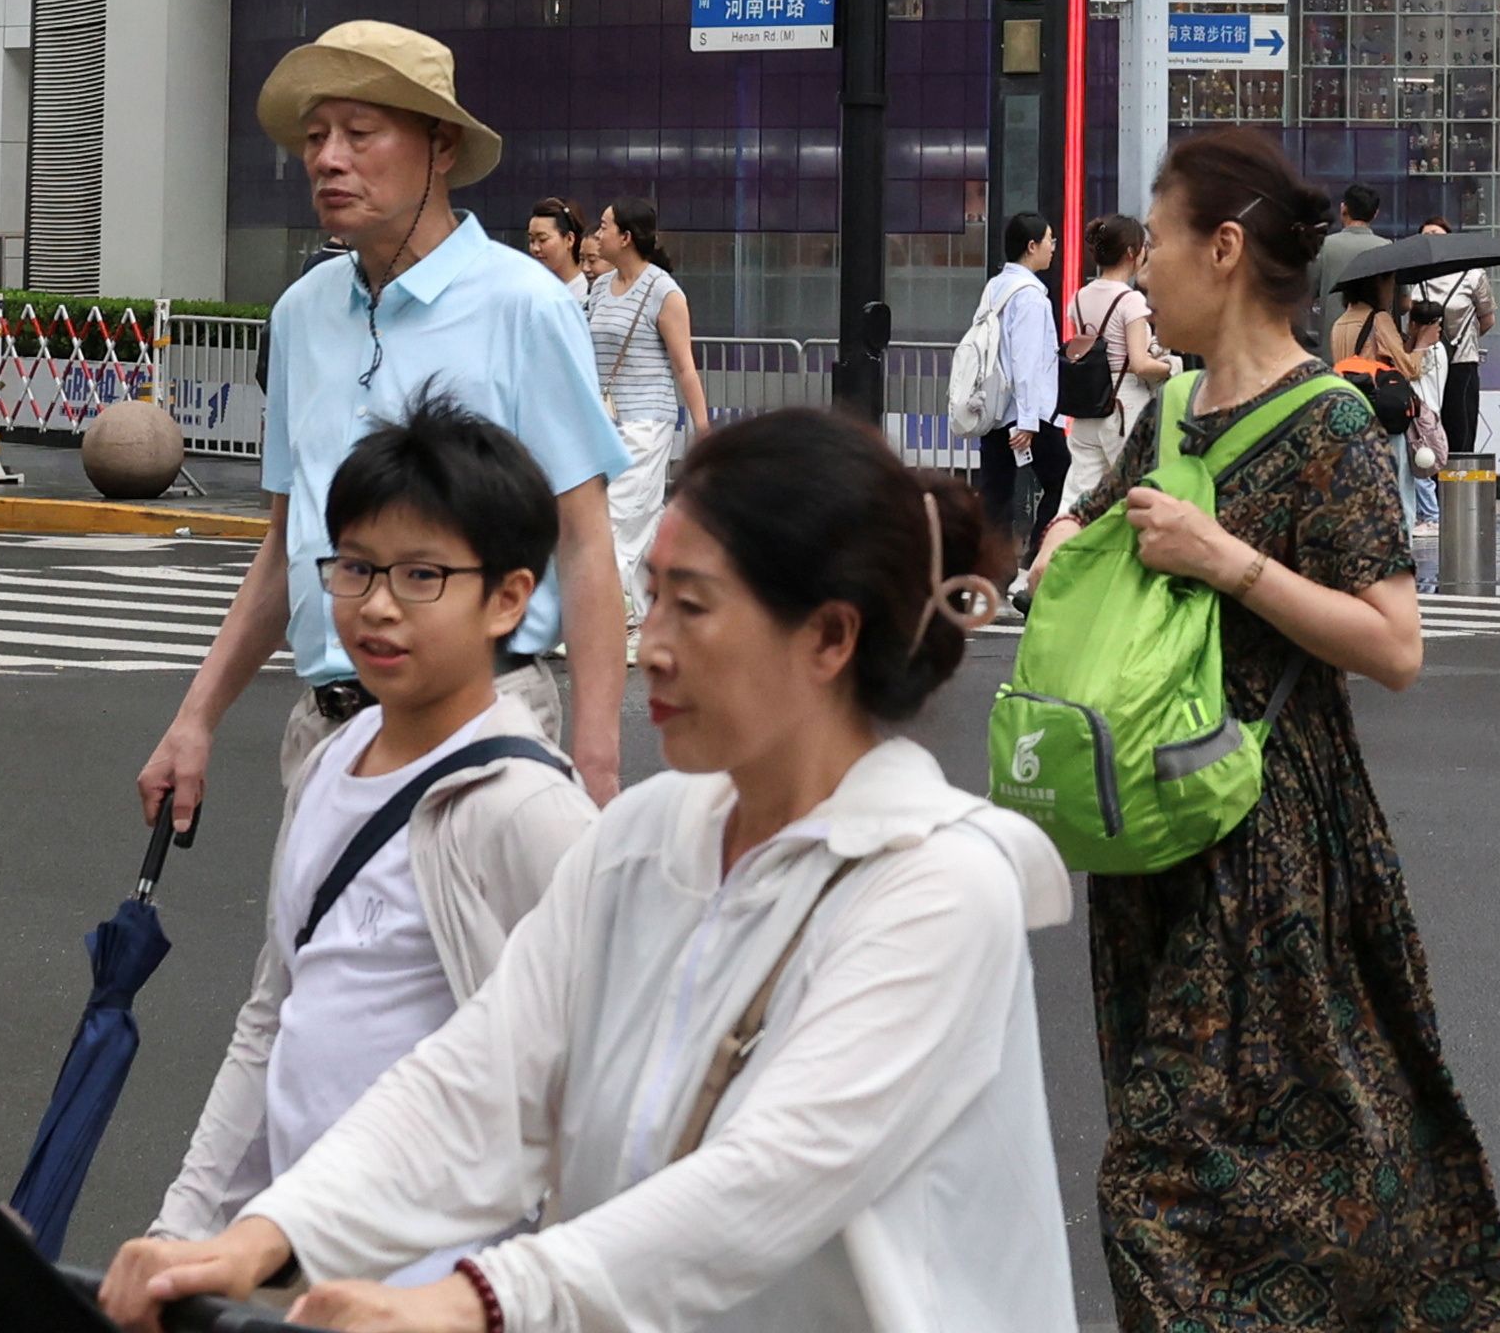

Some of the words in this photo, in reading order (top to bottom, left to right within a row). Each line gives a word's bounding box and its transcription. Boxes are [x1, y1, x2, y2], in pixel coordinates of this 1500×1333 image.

[699, 32, 708, 46] S
[731, 30, 761, 43] Henan
[819, 29, 829, 44] N
